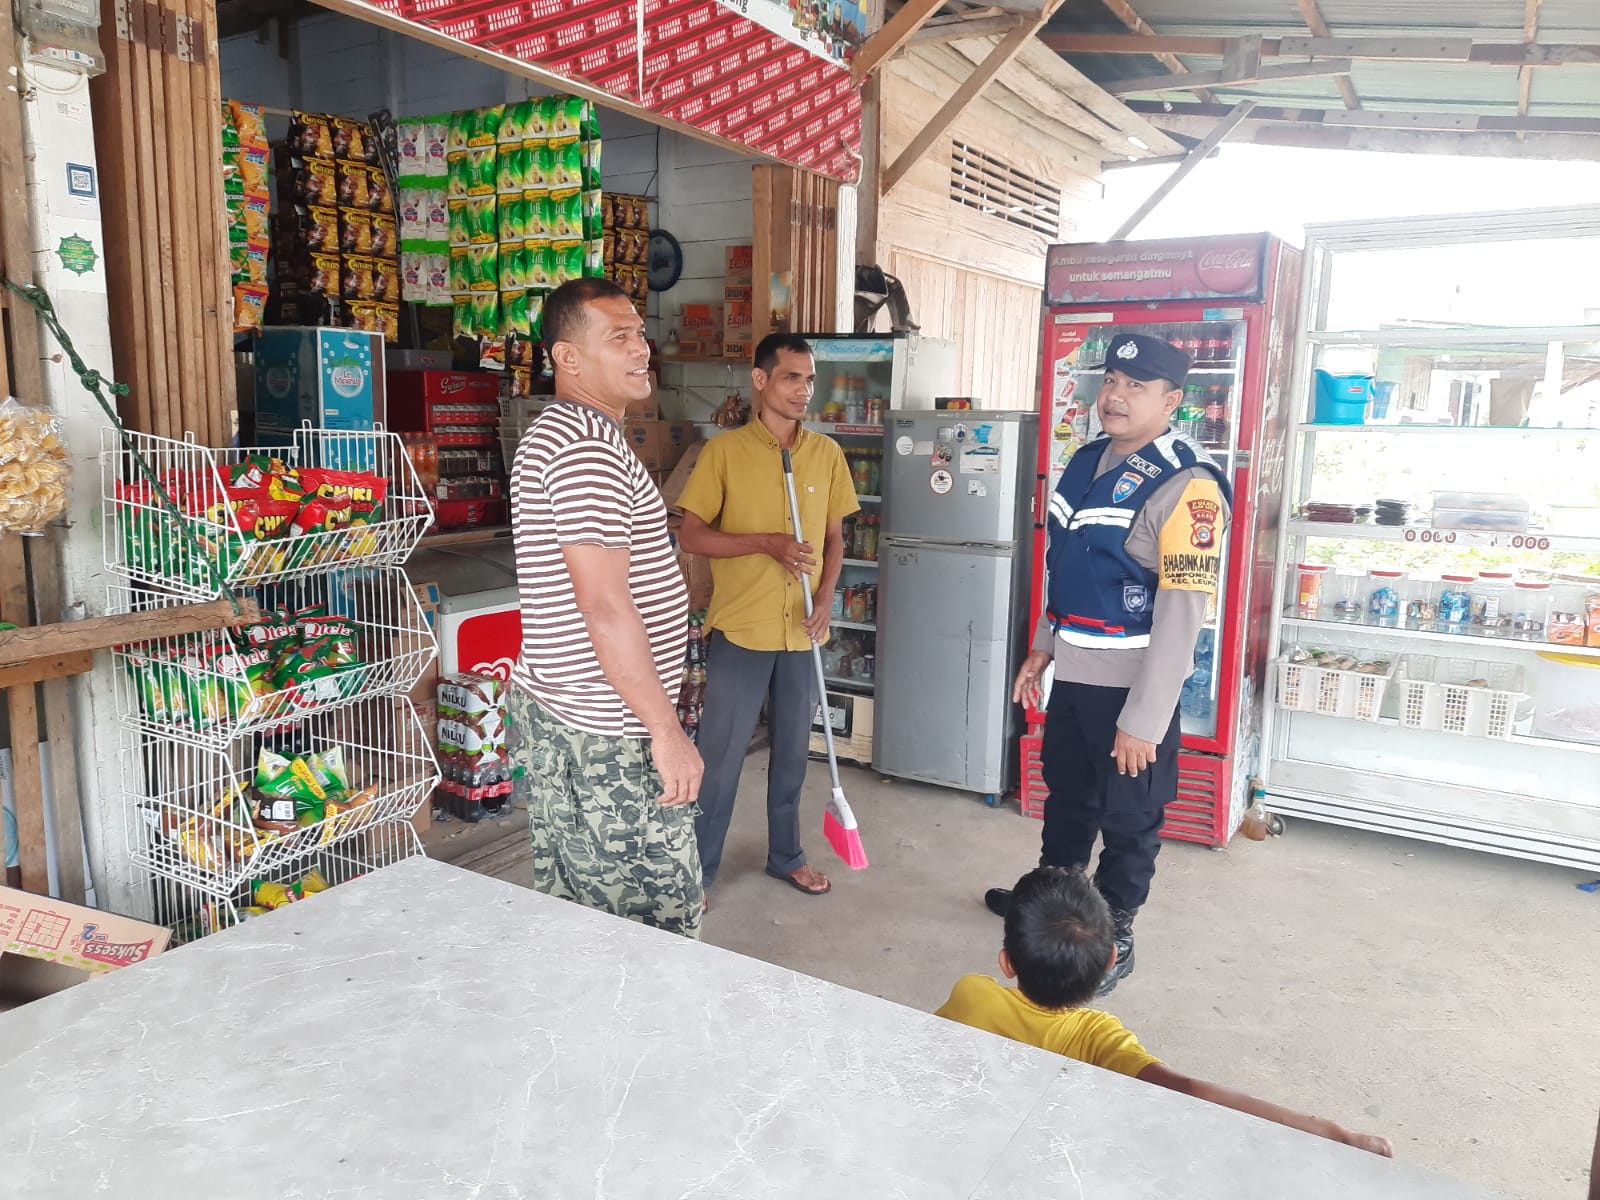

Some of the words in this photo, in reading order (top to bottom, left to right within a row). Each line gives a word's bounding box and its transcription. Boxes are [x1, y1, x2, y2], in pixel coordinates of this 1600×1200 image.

[1069, 271, 1099, 283] untuk
[1101, 267, 1172, 283] semangatmu
[1131, 457, 1160, 477] POLRI
[250, 623, 298, 644] Qtela
[303, 622, 353, 639] Qtela
[441, 691, 467, 708] MILKU
[441, 726, 466, 745] MILKU
[81, 925, 97, 941] 2
